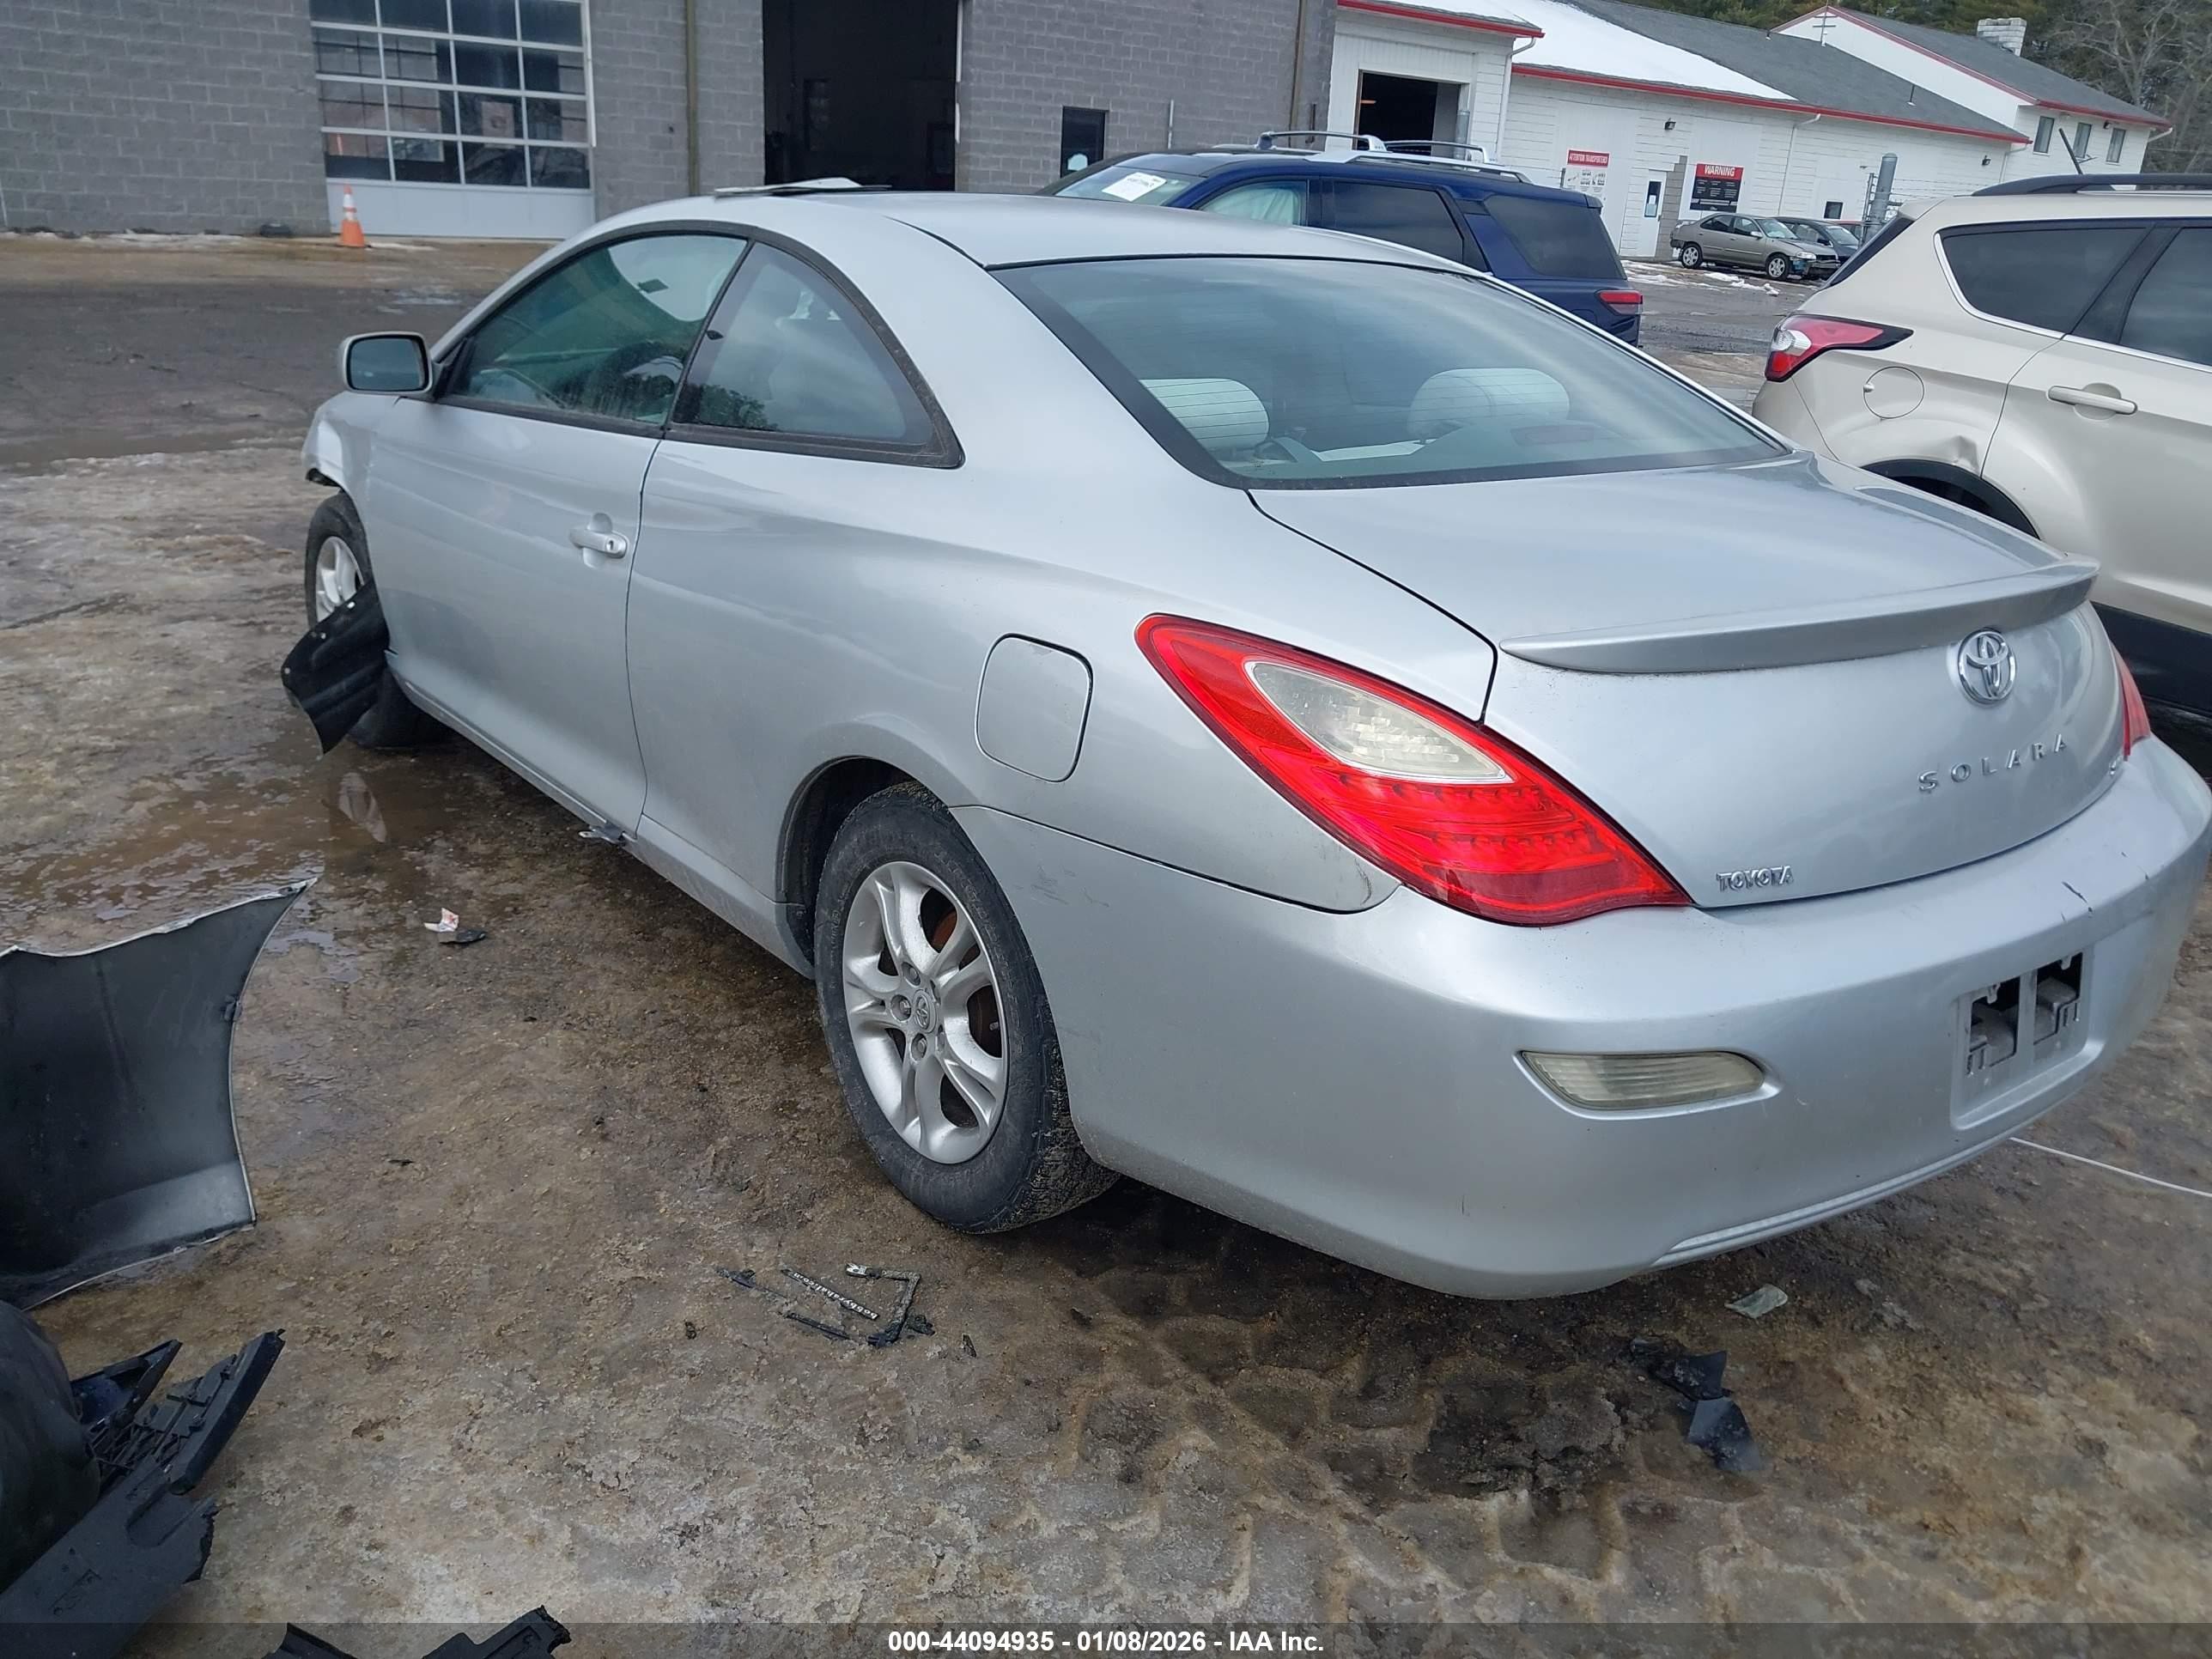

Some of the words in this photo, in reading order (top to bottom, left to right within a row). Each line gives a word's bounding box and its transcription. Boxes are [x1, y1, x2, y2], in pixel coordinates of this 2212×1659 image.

[1705, 165, 1735, 177] WARNING
[1918, 733, 2069, 792] SOLARA
[1716, 865, 1795, 892] TOYOTA
